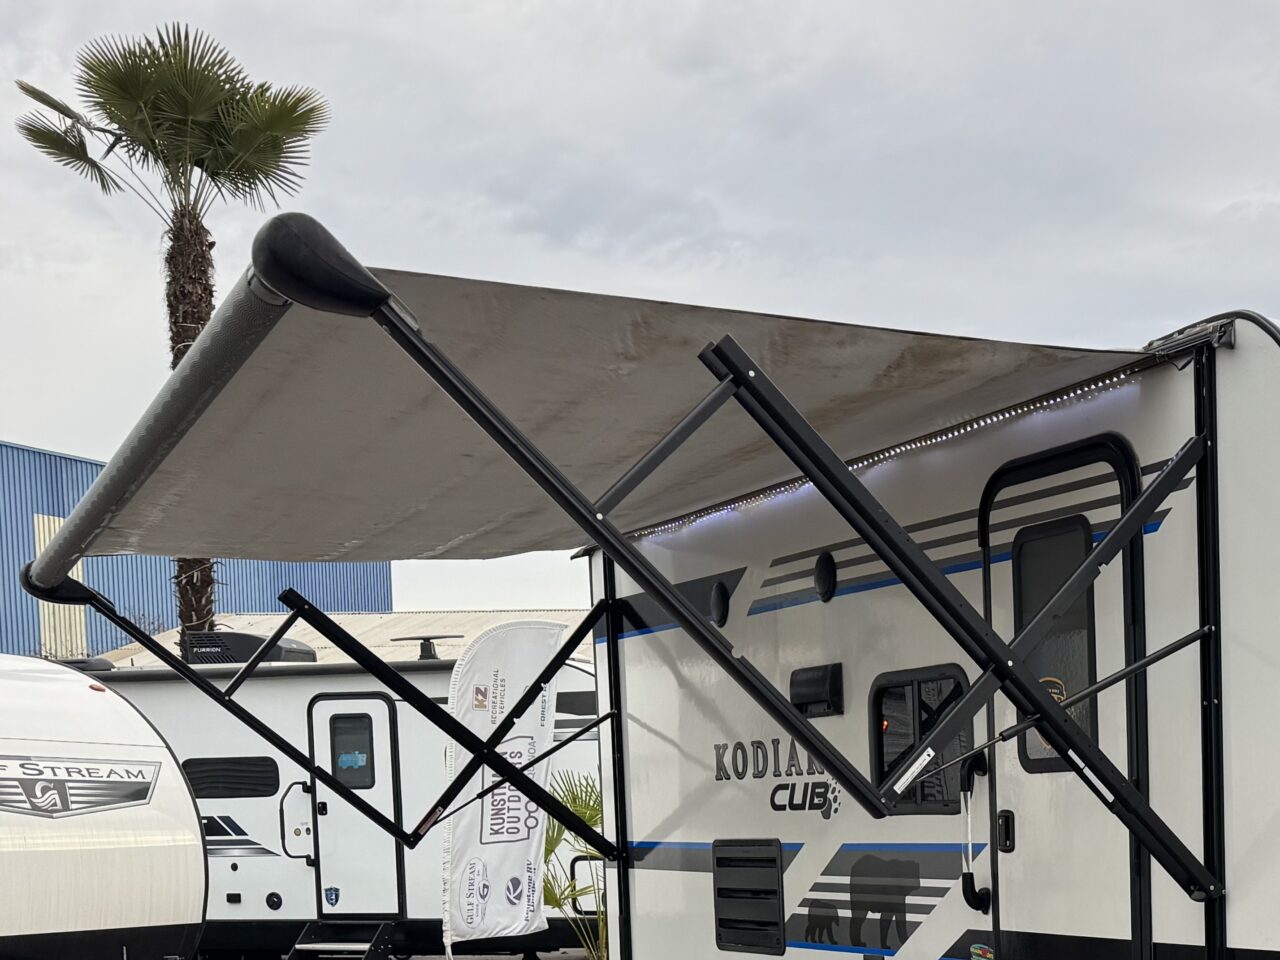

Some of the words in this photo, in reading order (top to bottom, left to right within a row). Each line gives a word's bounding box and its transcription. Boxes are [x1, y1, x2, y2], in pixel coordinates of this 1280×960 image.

[491, 668, 500, 725] RECREATIONAL
[498, 678, 506, 715] VEHICLES
[540, 694, 548, 727] FOREST
[19, 762, 147, 780] STREAM
[505, 751, 523, 835] OUTDS
[769, 781, 830, 811] CUB
